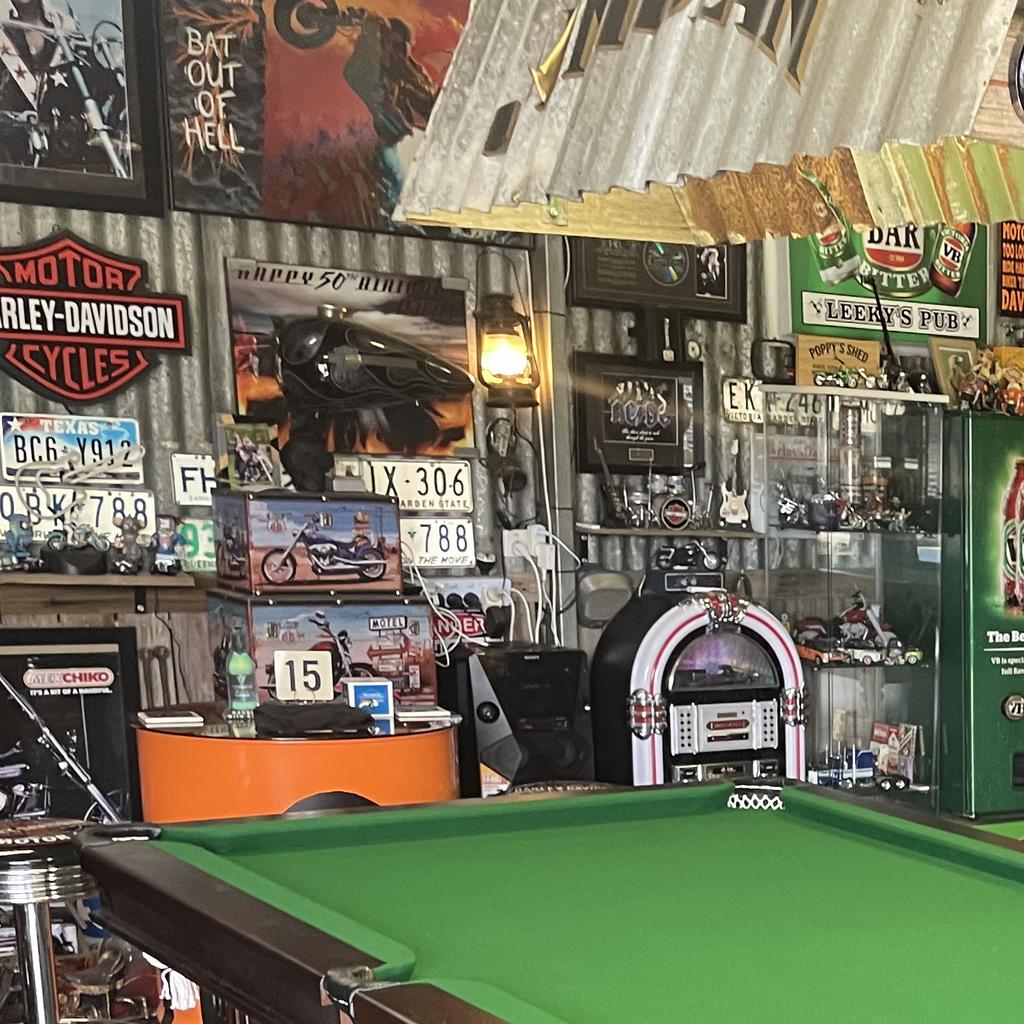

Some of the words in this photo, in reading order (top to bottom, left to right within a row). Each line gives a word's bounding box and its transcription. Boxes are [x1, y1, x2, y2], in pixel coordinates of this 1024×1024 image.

[186, 27, 237, 58] BAT
[184, 60, 239, 88] OUT
[195, 90, 237, 121] OF
[184, 118, 246, 153] HELL
[868, 222, 920, 249] BAR
[943, 243, 962, 263] VB
[14, 250, 125, 291] MOTOR
[860, 259, 931, 288] BITTER
[826, 301, 912, 326] LEEKY'S
[920, 310, 959, 329] PUB
[809, 341, 845, 359] POPPY'S
[846, 343, 869, 363] SHED
[22, 344, 131, 391] CYCLES
[40, 418, 99, 435] TEXAS
[400, 500, 434, 508] ARDEN
[439, 500, 469, 509] STATE
[420, 523, 468, 553] 788
[418, 556, 438, 564] THE
[986, 630, 1010, 643] The
[62, 671, 110, 683] CHIKO
[284, 659, 322, 692] 15
